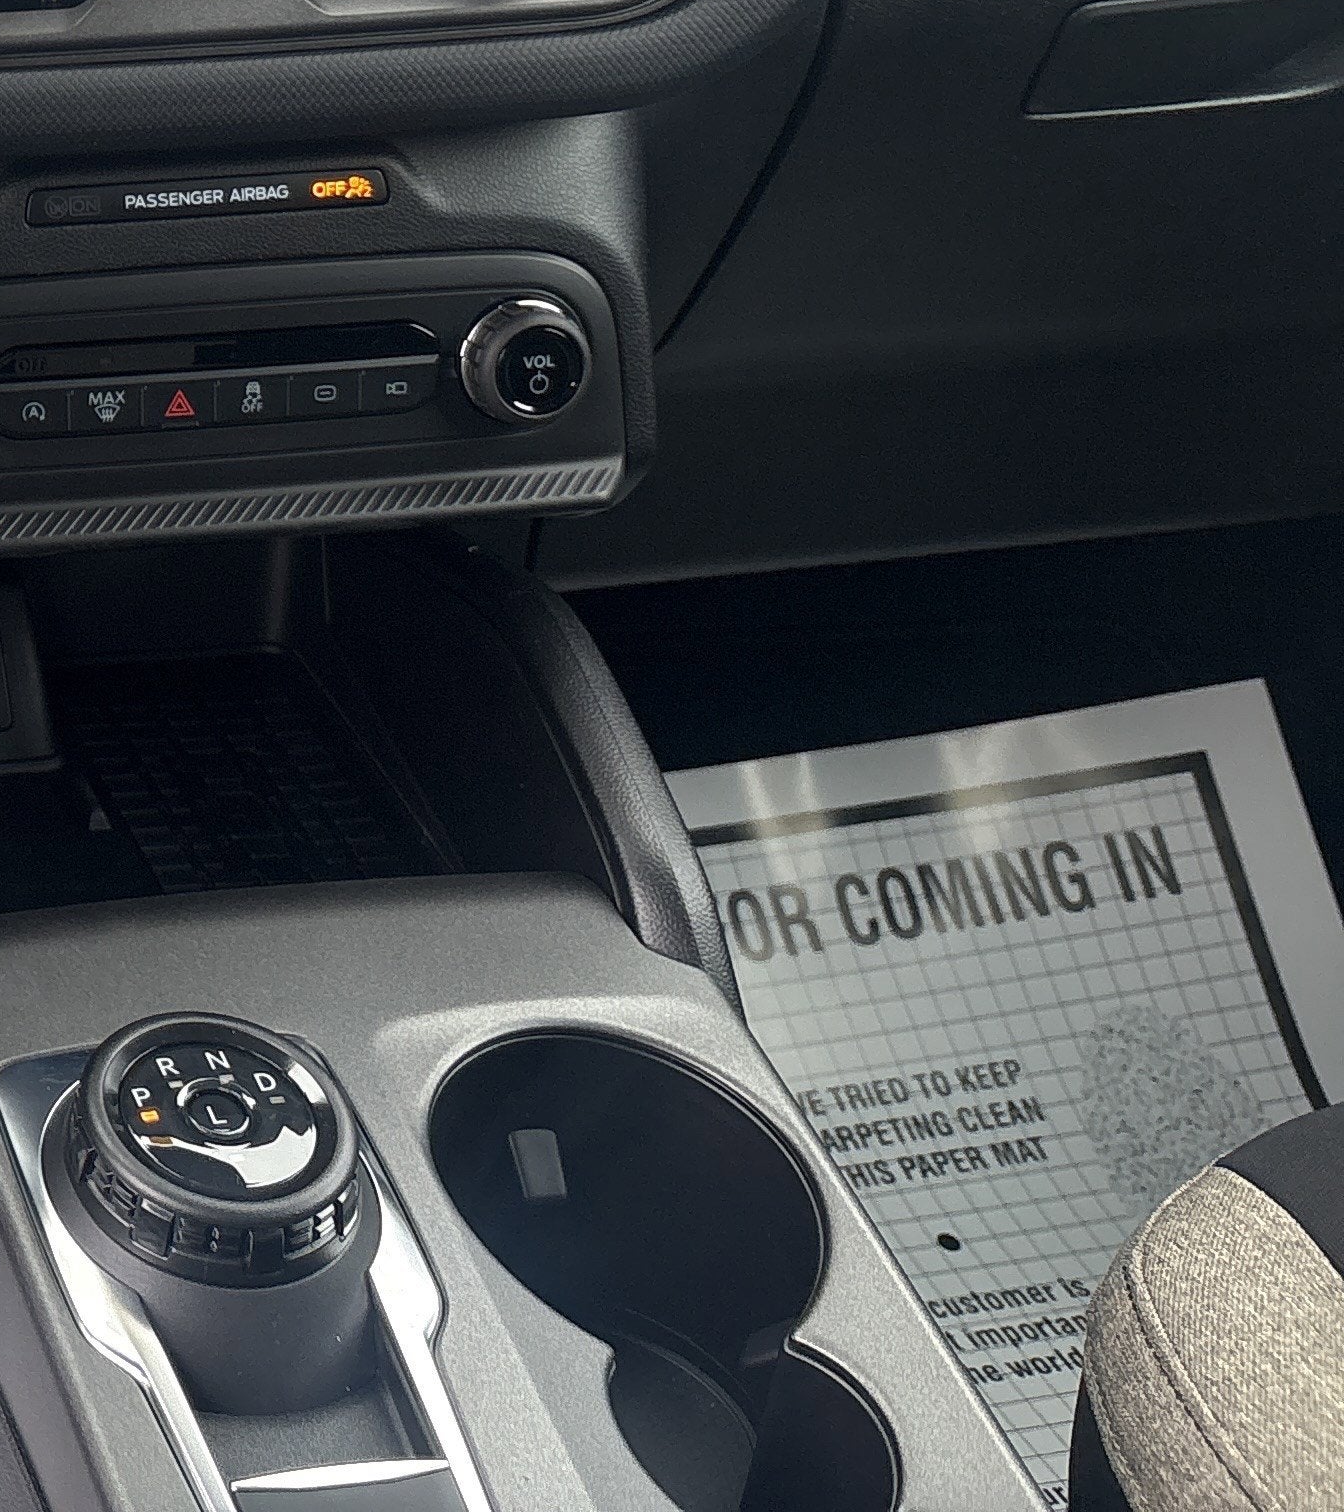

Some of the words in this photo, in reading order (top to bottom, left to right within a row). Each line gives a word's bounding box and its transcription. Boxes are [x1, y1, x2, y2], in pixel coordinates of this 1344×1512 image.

[124, 189, 224, 211] PASSENGER
[229, 184, 290, 203] AIRBAG
[311, 180, 347, 199] OFF
[522, 354, 556, 369] VOL
[87, 389, 126, 406] MAX
[240, 401, 264, 414] OFF
[724, 882, 826, 962] OR
[833, 839, 1096, 946] COMING
[1103, 824, 1183, 903] IN
[156, 1056, 180, 1078] R
[205, 1050, 230, 1072] N
[254, 1072, 276, 1092] D
[825, 1076, 911, 1113] TRIED
[911, 1069, 952, 1100] TO
[954, 1059, 1021, 1094] KEEP
[131, 1087, 152, 1107] P
[206, 1105, 228, 1125] L
[819, 1110, 954, 1152] ARPETING
[956, 1096, 1047, 1133] CLEAN
[839, 1159, 897, 1189] HIS
[897, 1146, 991, 1182] PAPER
[989, 1136, 1049, 1168] MAT
[927, 1285, 1058, 1319] customer
[1057, 1276, 1092, 1299] is
